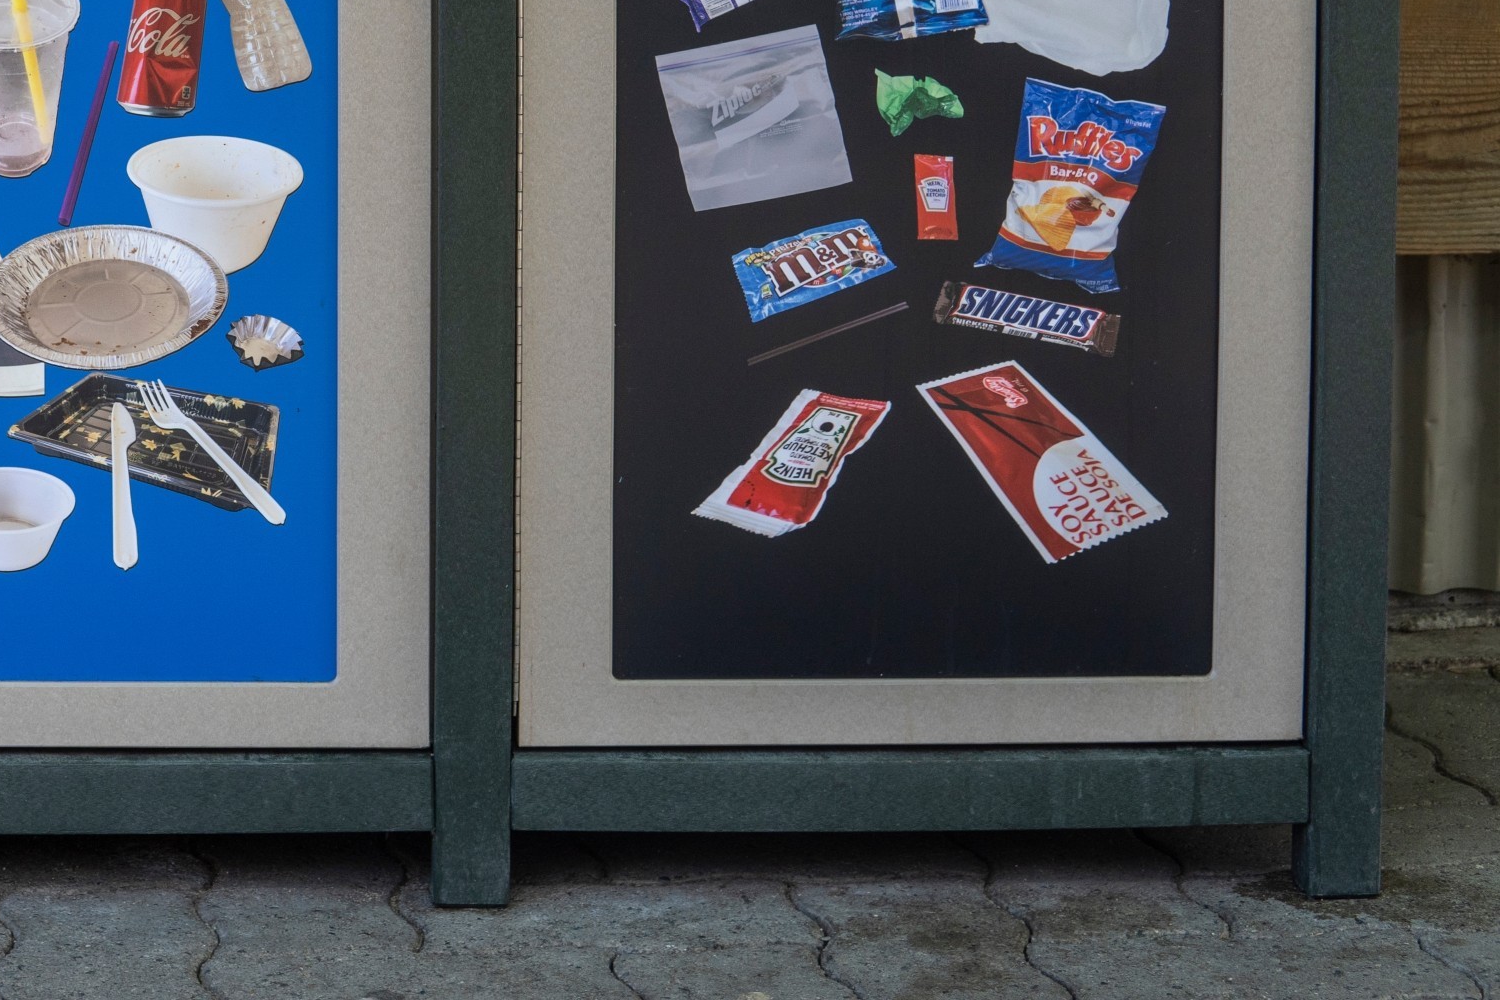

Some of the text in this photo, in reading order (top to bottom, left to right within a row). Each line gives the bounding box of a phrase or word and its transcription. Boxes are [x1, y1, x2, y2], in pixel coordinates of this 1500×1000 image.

[127, 7, 200, 58] Cola
[706, 84, 762, 127] Ziploc
[1028, 116, 1143, 172] Ruffles
[956, 287, 1100, 337] SNICKERS
[773, 463, 814, 479] HEINZ
[783, 442, 834, 462] KETCHUP
[790, 452, 816, 462] TOMATO
[1049, 471, 1110, 536] SAUCE
[1071, 466, 1131, 527] SAUCE
[1115, 492, 1147, 520] DE
[1048, 503, 1092, 544] SOY
